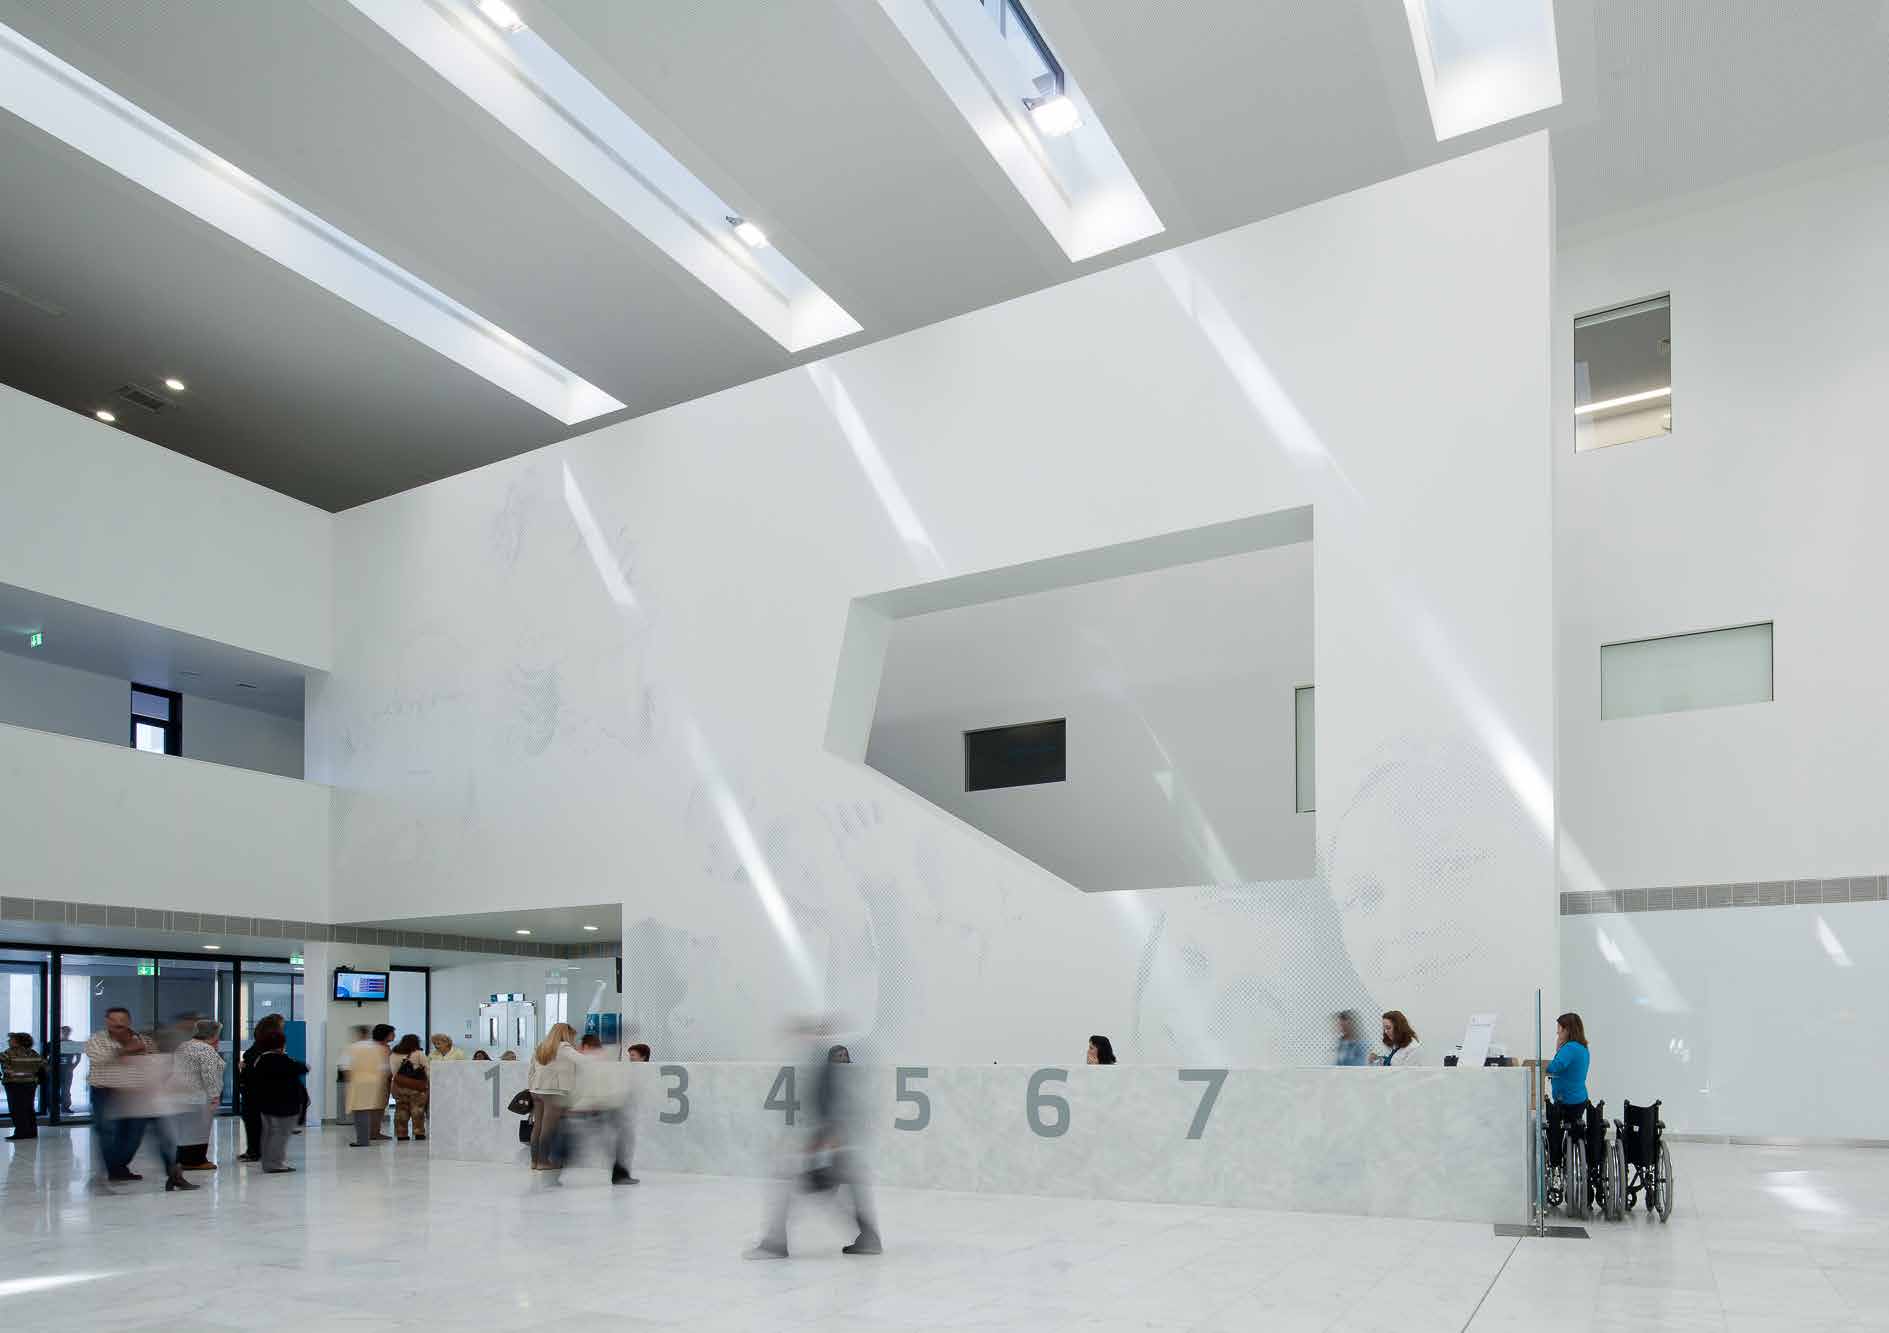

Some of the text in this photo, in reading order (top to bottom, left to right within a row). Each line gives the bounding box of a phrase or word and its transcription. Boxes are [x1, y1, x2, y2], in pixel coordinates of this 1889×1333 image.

[484, 1063, 500, 1118] 1
[659, 1065, 690, 1124] 3
[763, 1066, 800, 1126] 4
[894, 1067, 931, 1131] 5
[1026, 1068, 1071, 1138] 6
[1178, 1069, 1230, 1140] 7
